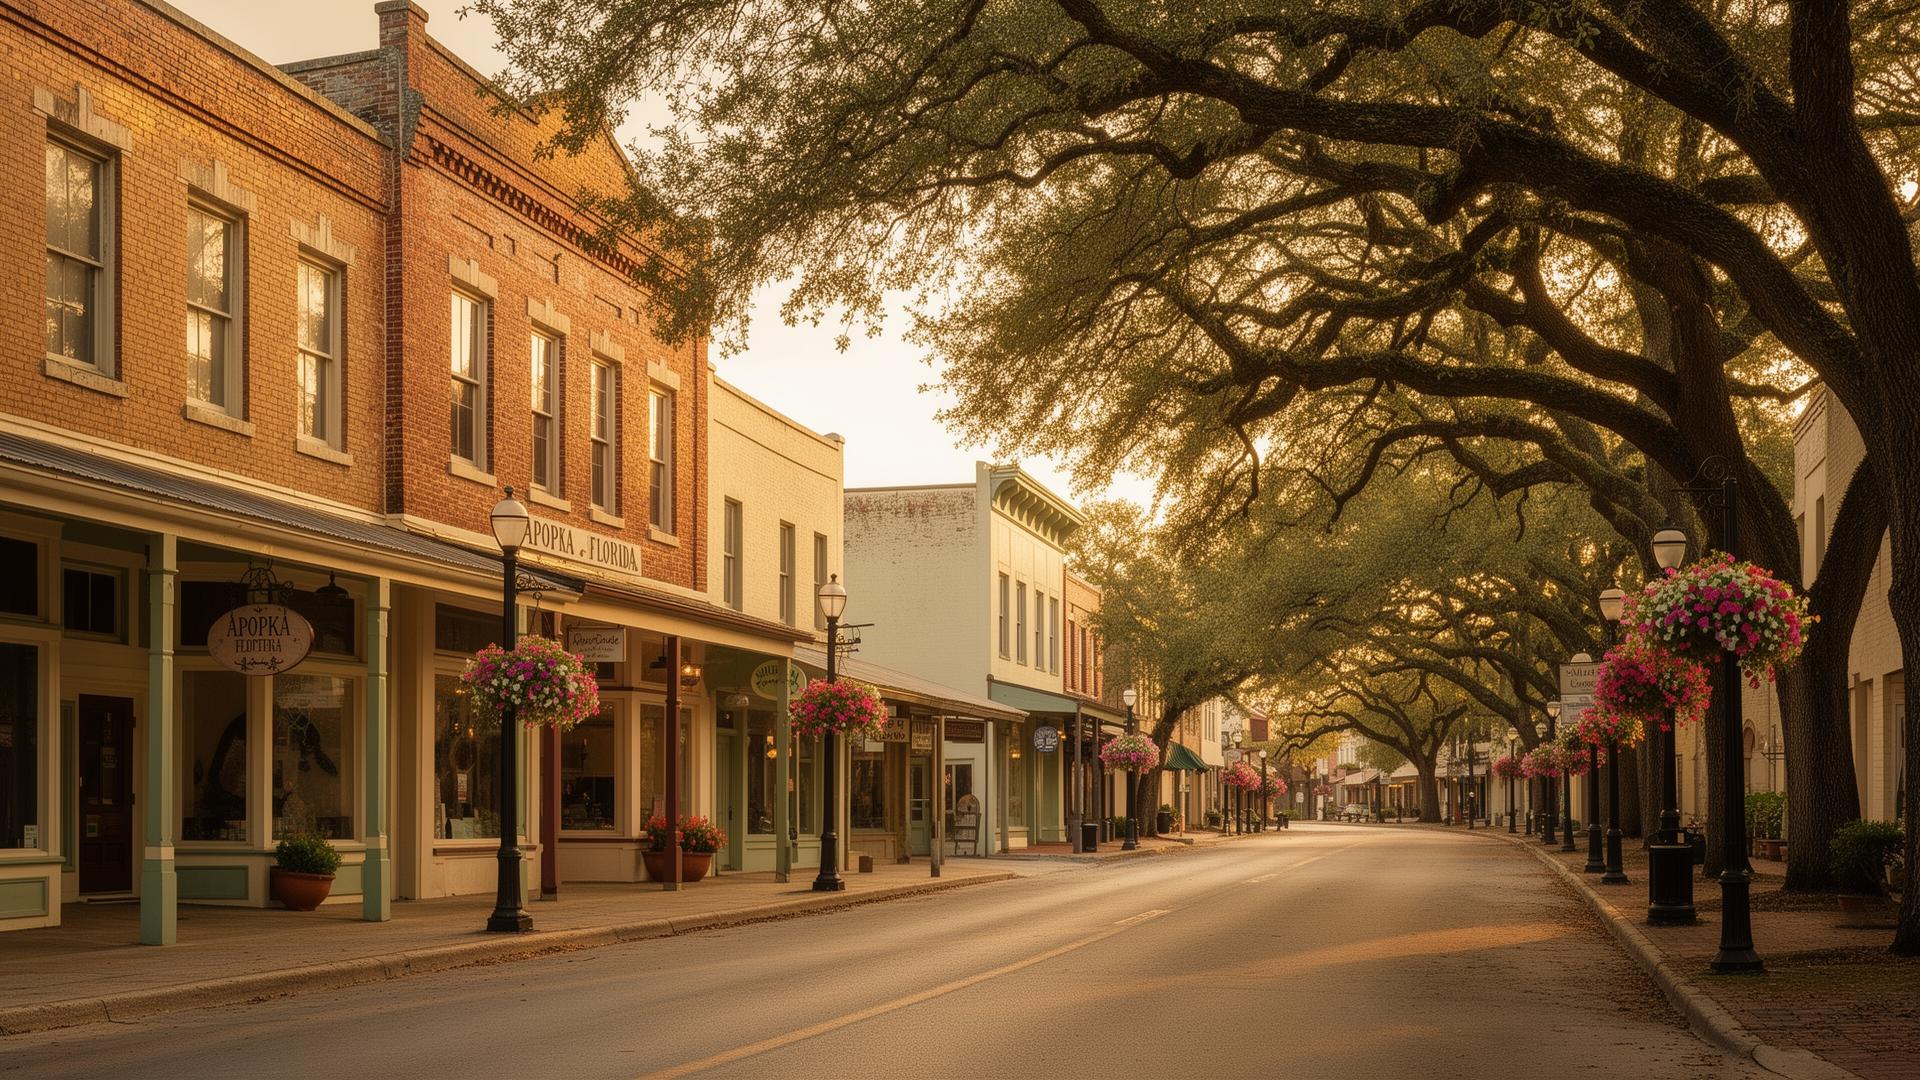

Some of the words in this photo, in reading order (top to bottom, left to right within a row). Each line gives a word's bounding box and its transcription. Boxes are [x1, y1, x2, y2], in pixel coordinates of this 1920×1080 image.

[522, 519, 575, 555] APOPKA
[590, 536, 639, 572] FLORIDA
[226, 615, 290, 637] APOPKA
